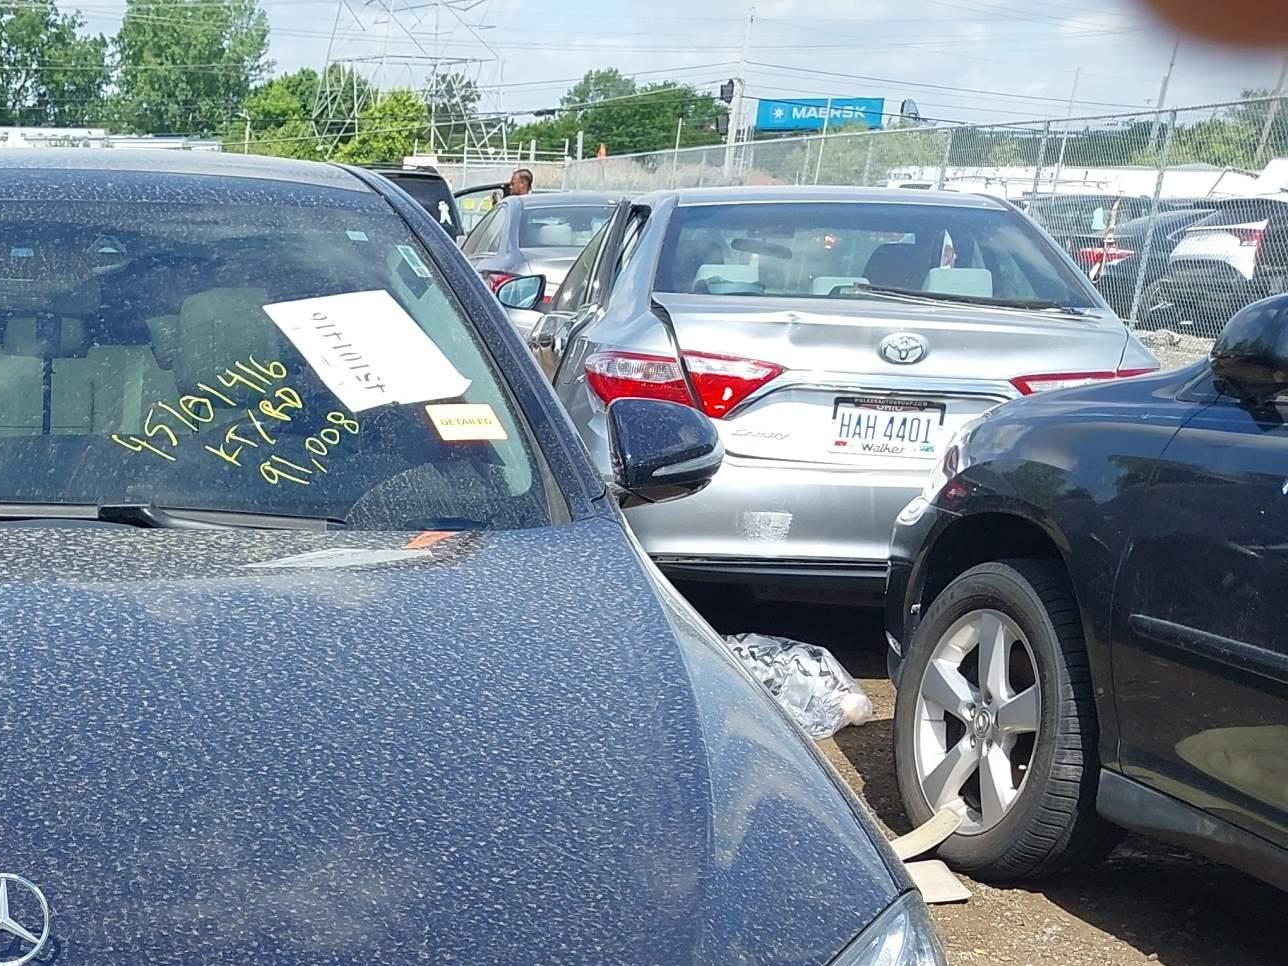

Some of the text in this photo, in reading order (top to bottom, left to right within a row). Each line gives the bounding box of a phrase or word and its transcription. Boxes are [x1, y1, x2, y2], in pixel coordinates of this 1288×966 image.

[791, 105, 867, 119] MAERSK
[111, 354, 287, 461] 45101416
[440, 418, 493, 426] DETAILED
[838, 412, 932, 443] HAH 4401
[259, 411, 360, 485] 91,008
[861, 443, 906, 454] Walker
